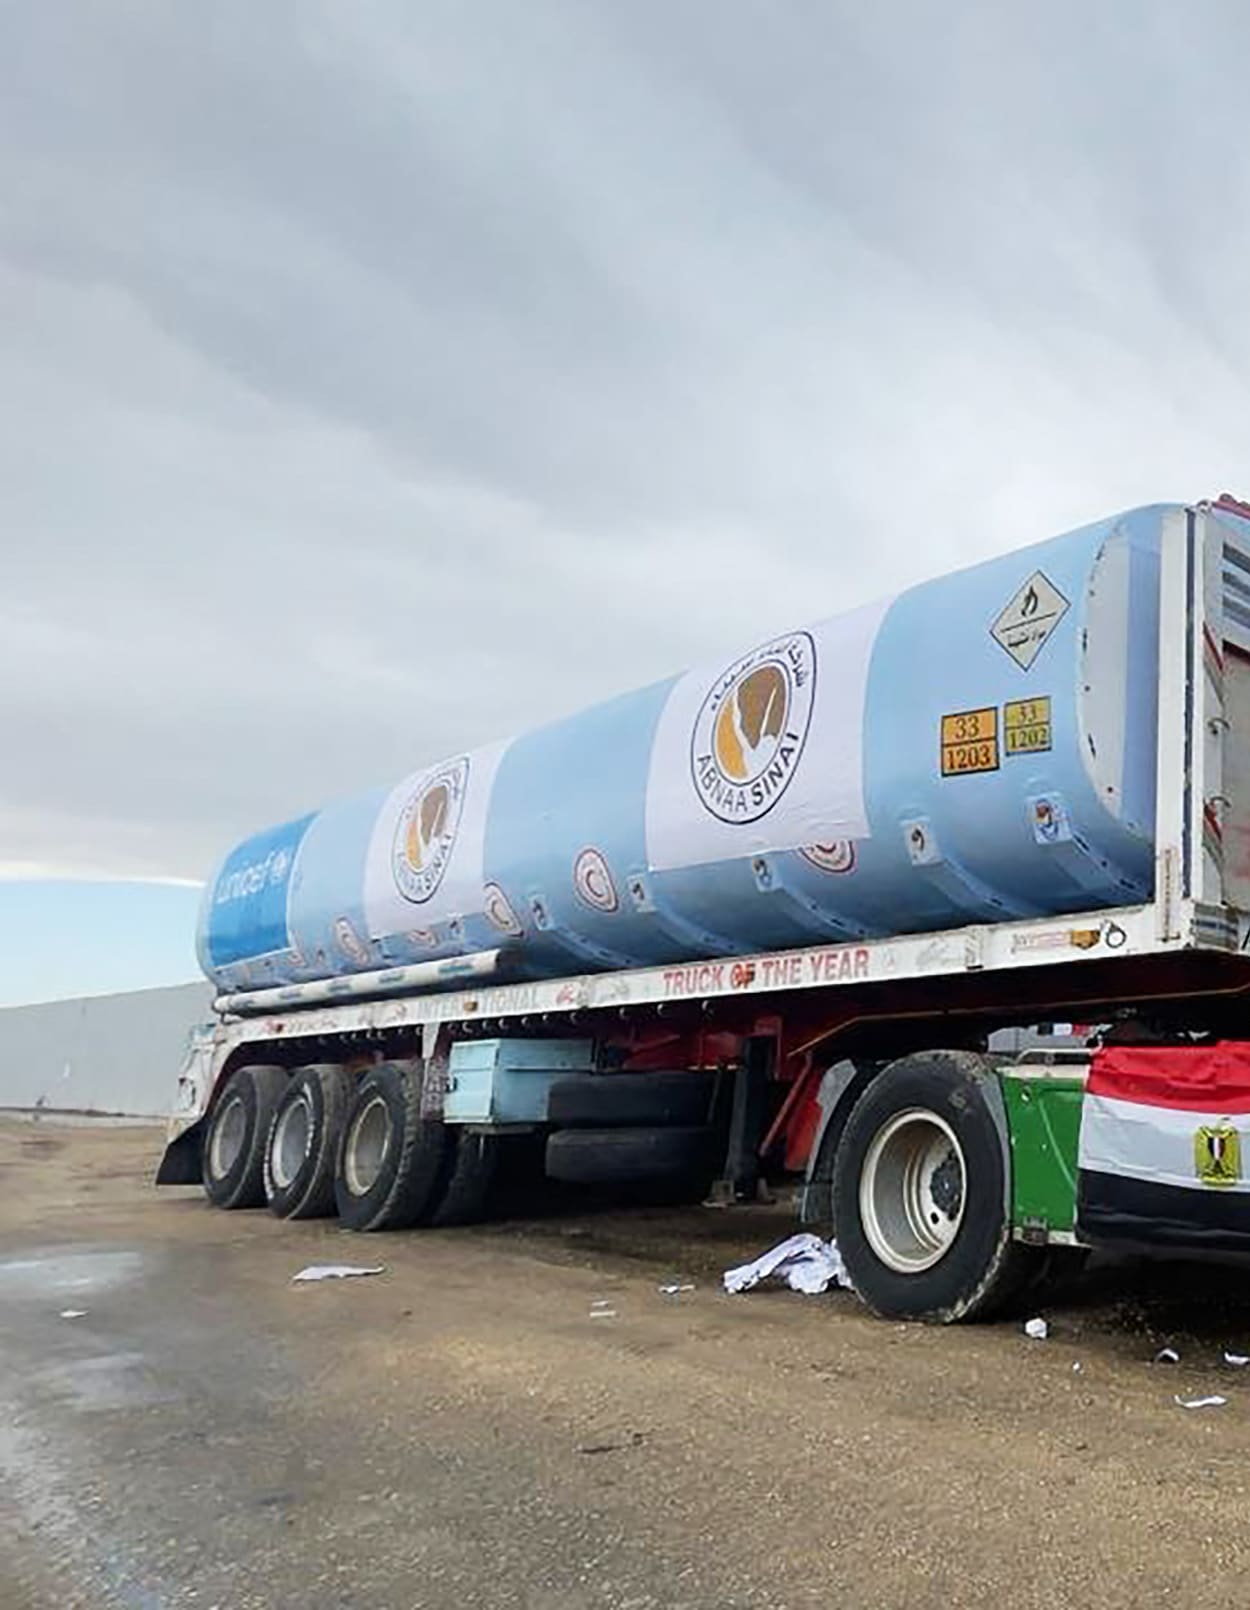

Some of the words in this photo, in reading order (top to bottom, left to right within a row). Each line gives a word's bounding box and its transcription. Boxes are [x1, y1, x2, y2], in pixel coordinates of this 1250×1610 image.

[1017, 704, 1038, 723] 33
[955, 716, 980, 739] 33
[1008, 727, 1048, 750] 1202
[948, 745, 991, 770] 1203
[697, 754, 749, 813] ABNAA
[750, 731, 800, 806] SINAI
[663, 965, 725, 996] TRUCK
[730, 961, 757, 990] OF
[761, 956, 802, 986] THE
[809, 949, 870, 981] YEAR
